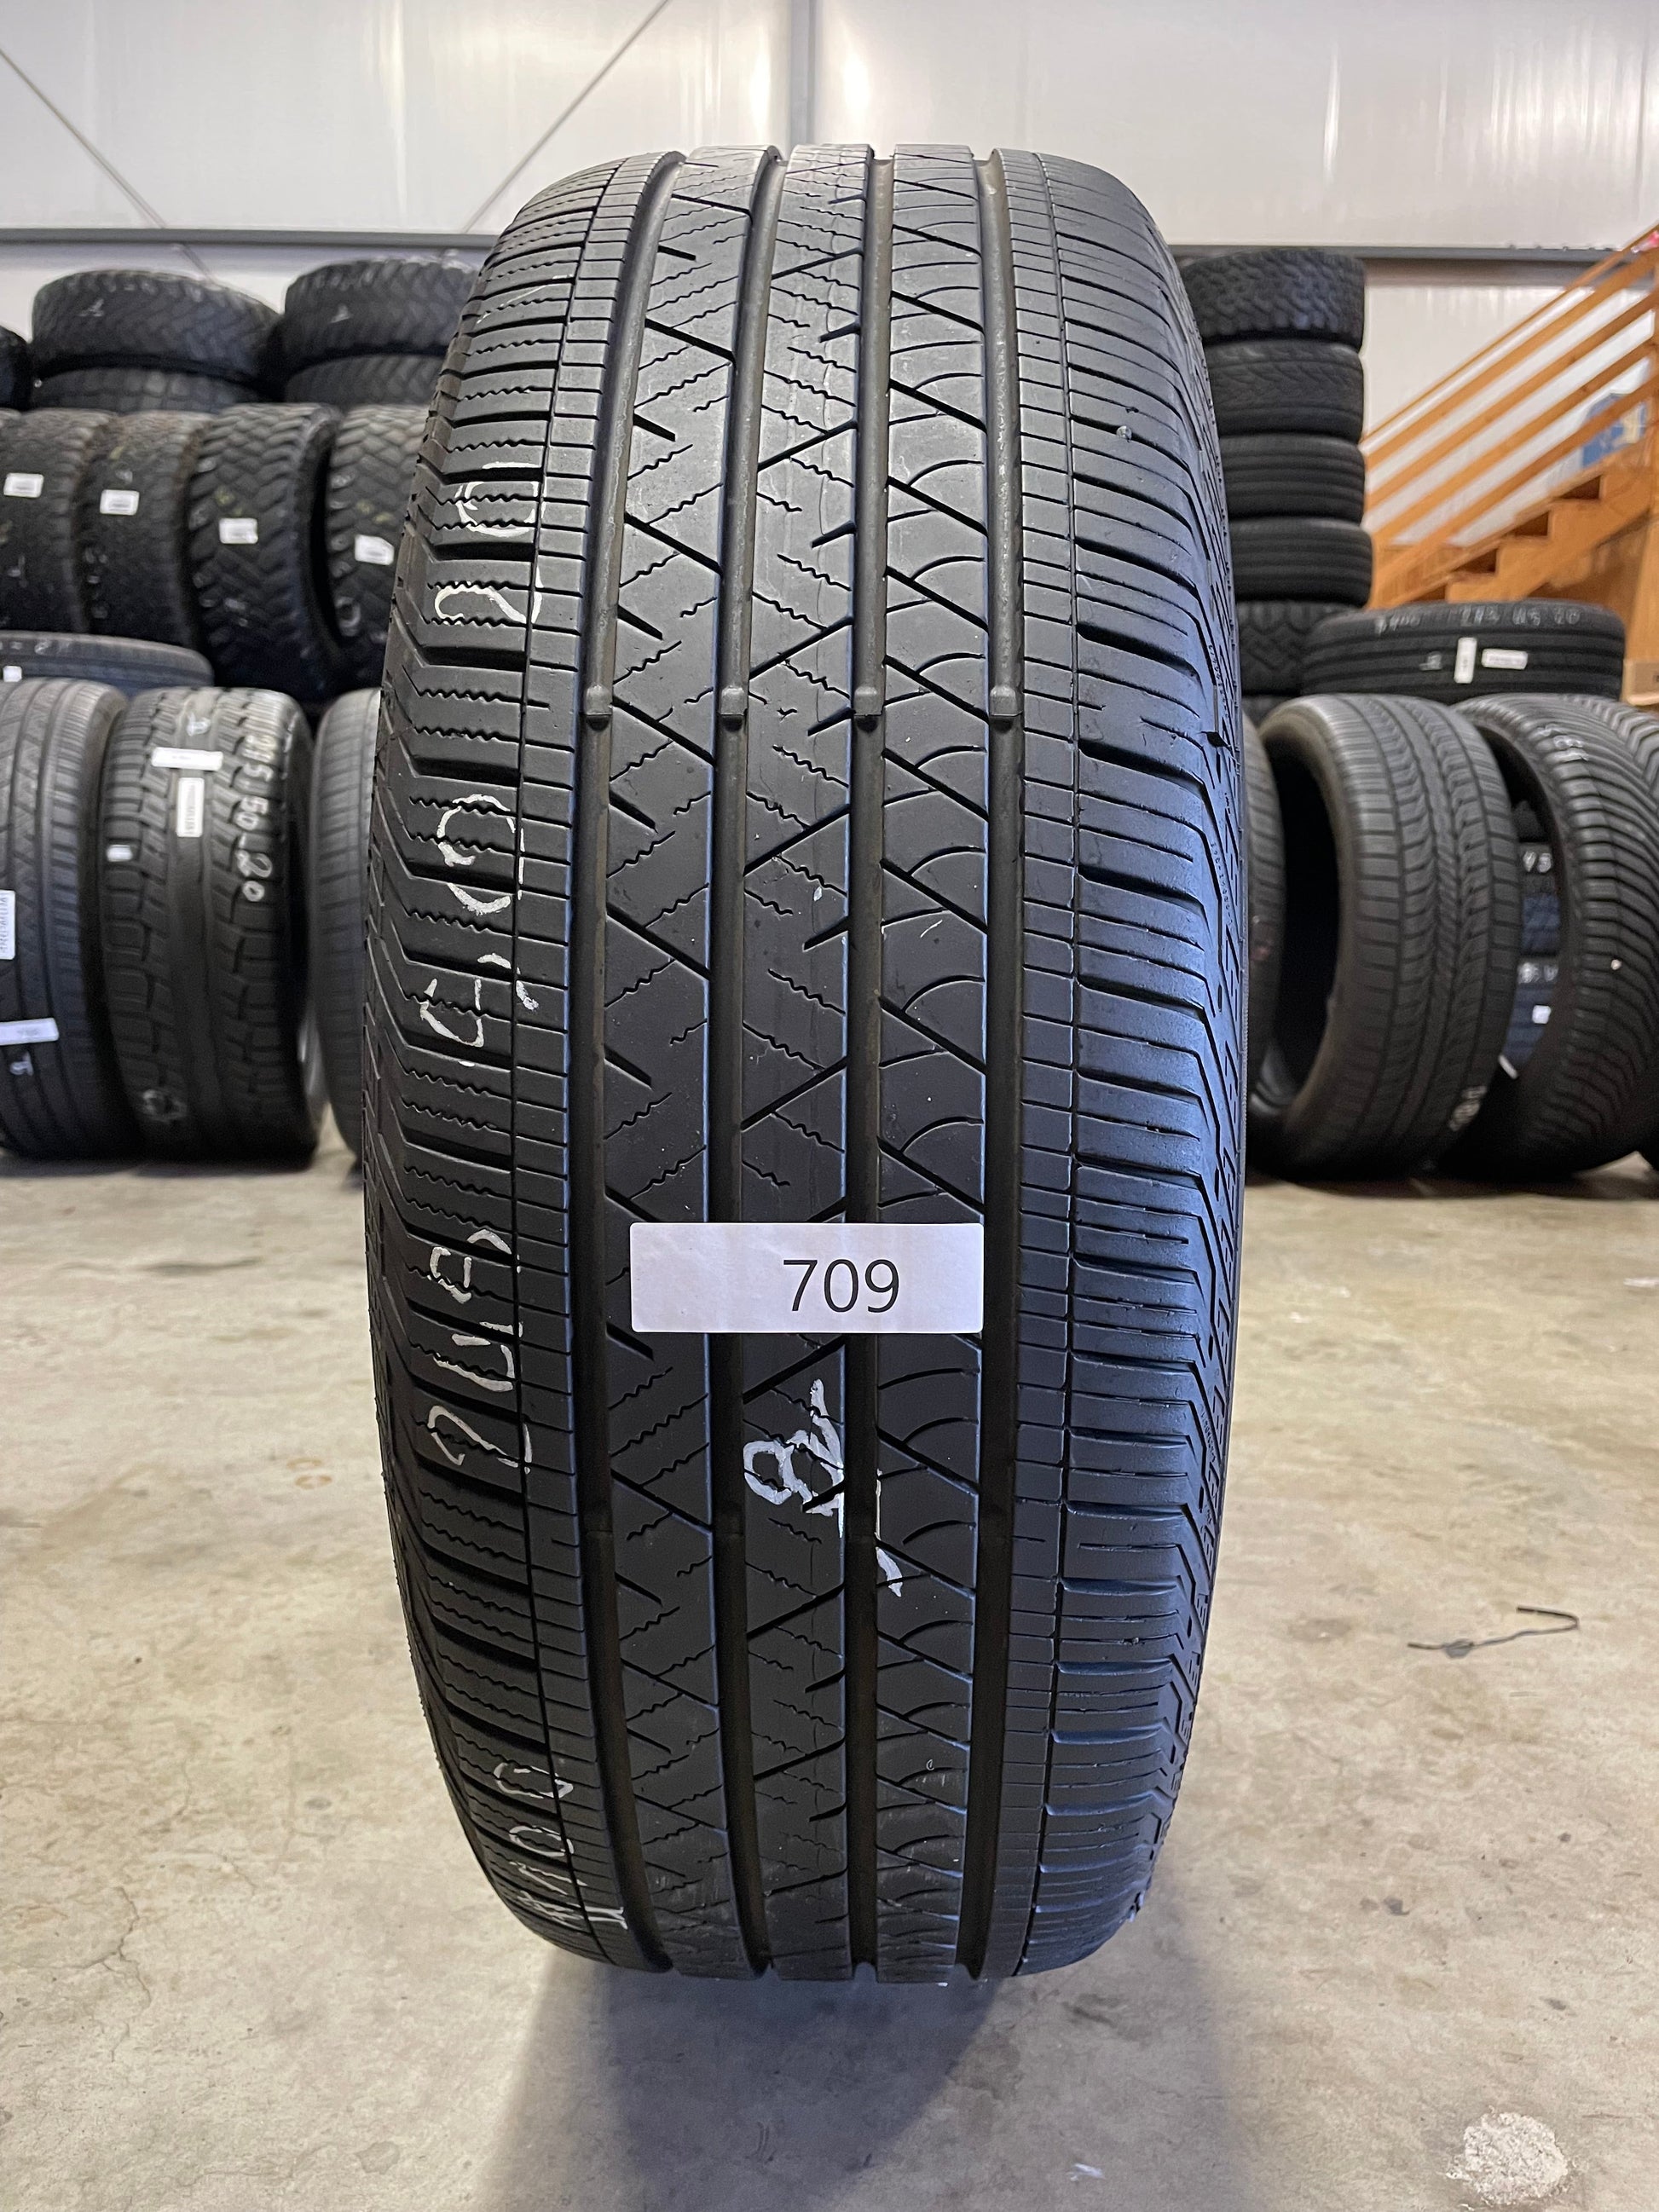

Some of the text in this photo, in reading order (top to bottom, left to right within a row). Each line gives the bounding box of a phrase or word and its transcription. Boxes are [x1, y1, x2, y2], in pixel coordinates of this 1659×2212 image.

[434, 461, 546, 626] 20
[234, 796, 269, 830] 50
[234, 850, 273, 902] 20
[783, 1259, 899, 1313] 709
